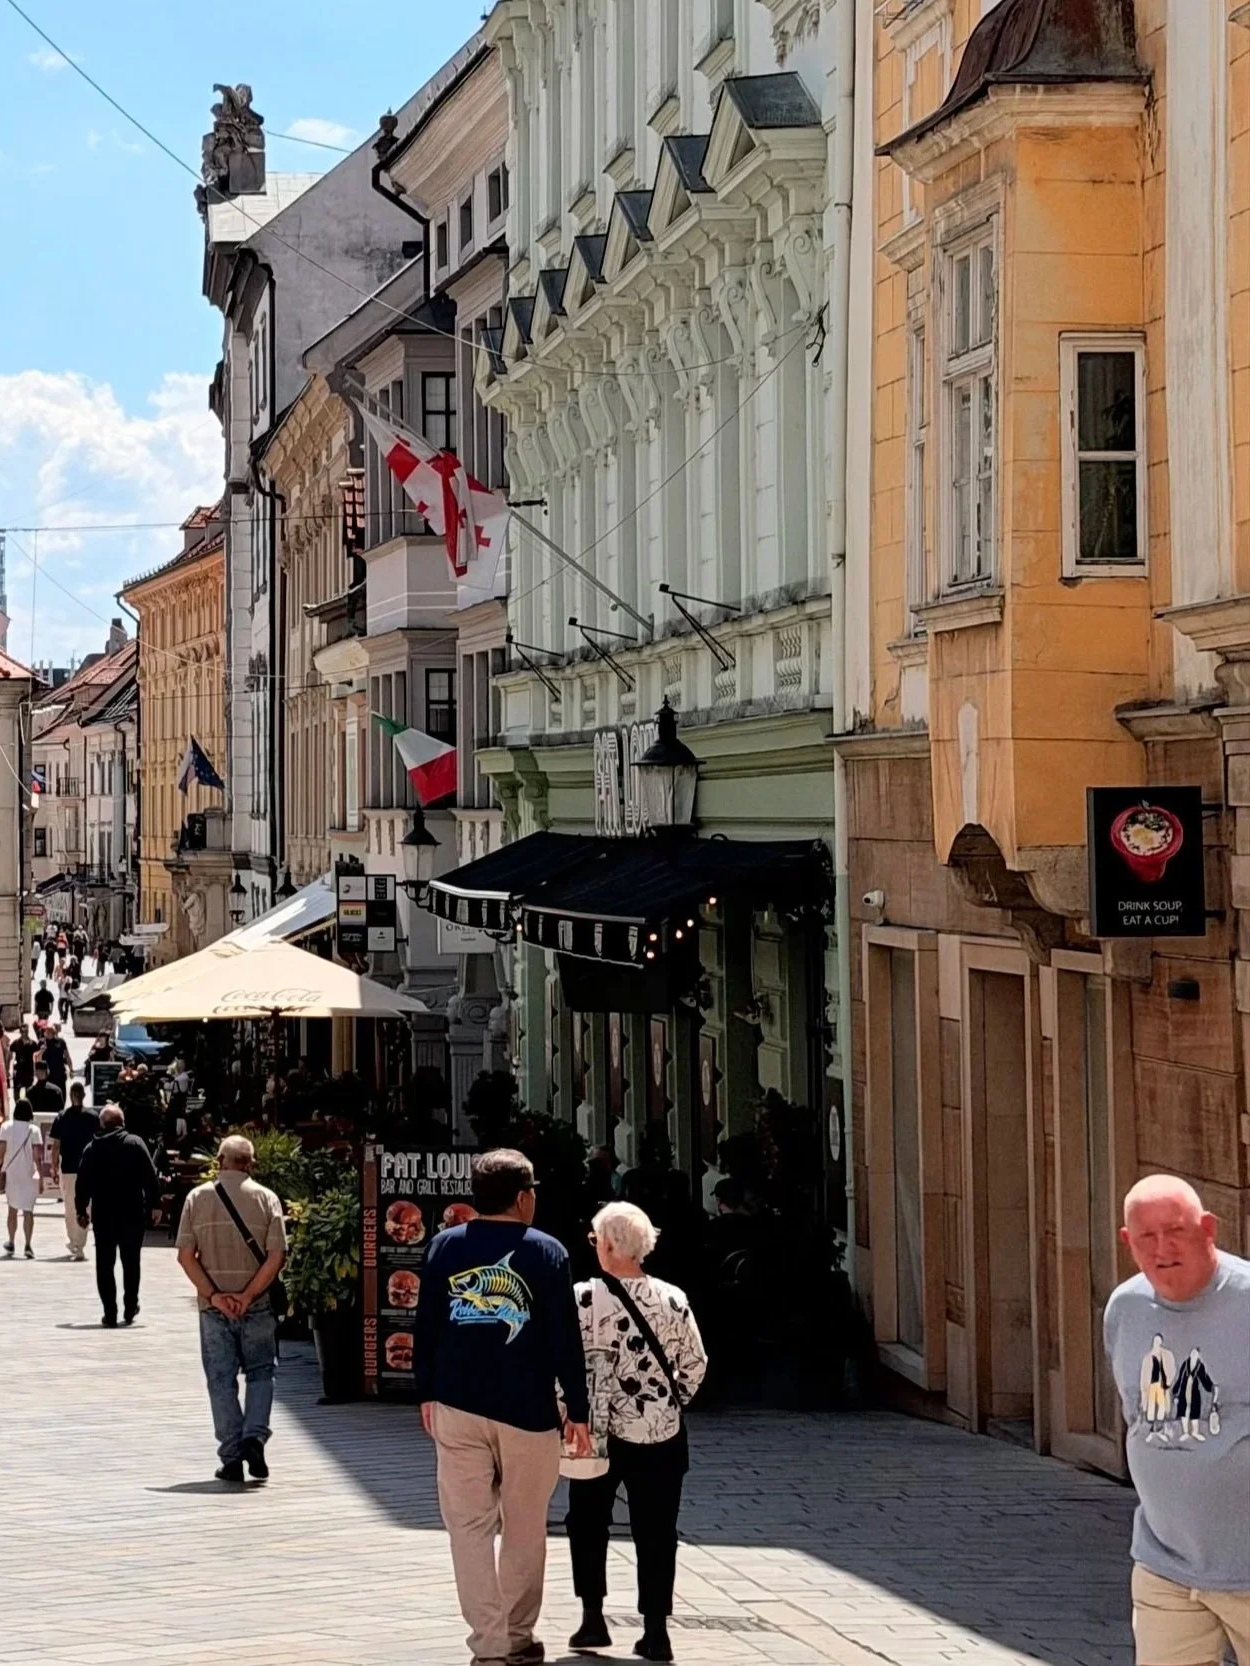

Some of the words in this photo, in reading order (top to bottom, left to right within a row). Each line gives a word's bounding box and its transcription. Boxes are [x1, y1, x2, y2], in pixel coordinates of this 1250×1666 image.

[1118, 901, 1151, 911] DRINK
[1123, 915, 1141, 926] EAT
[1144, 915, 1152, 925] A
[1154, 915, 1179, 925] CUP!
[381, 1152, 421, 1178] FAT
[426, 1152, 472, 1179] LOUI
[380, 1179, 396, 1195] BAR
[398, 1179, 414, 1195] AND
[417, 1179, 438, 1195] GRILL
[363, 1208, 377, 1267] BURGERS
[364, 1318, 377, 1376] BURGERS
